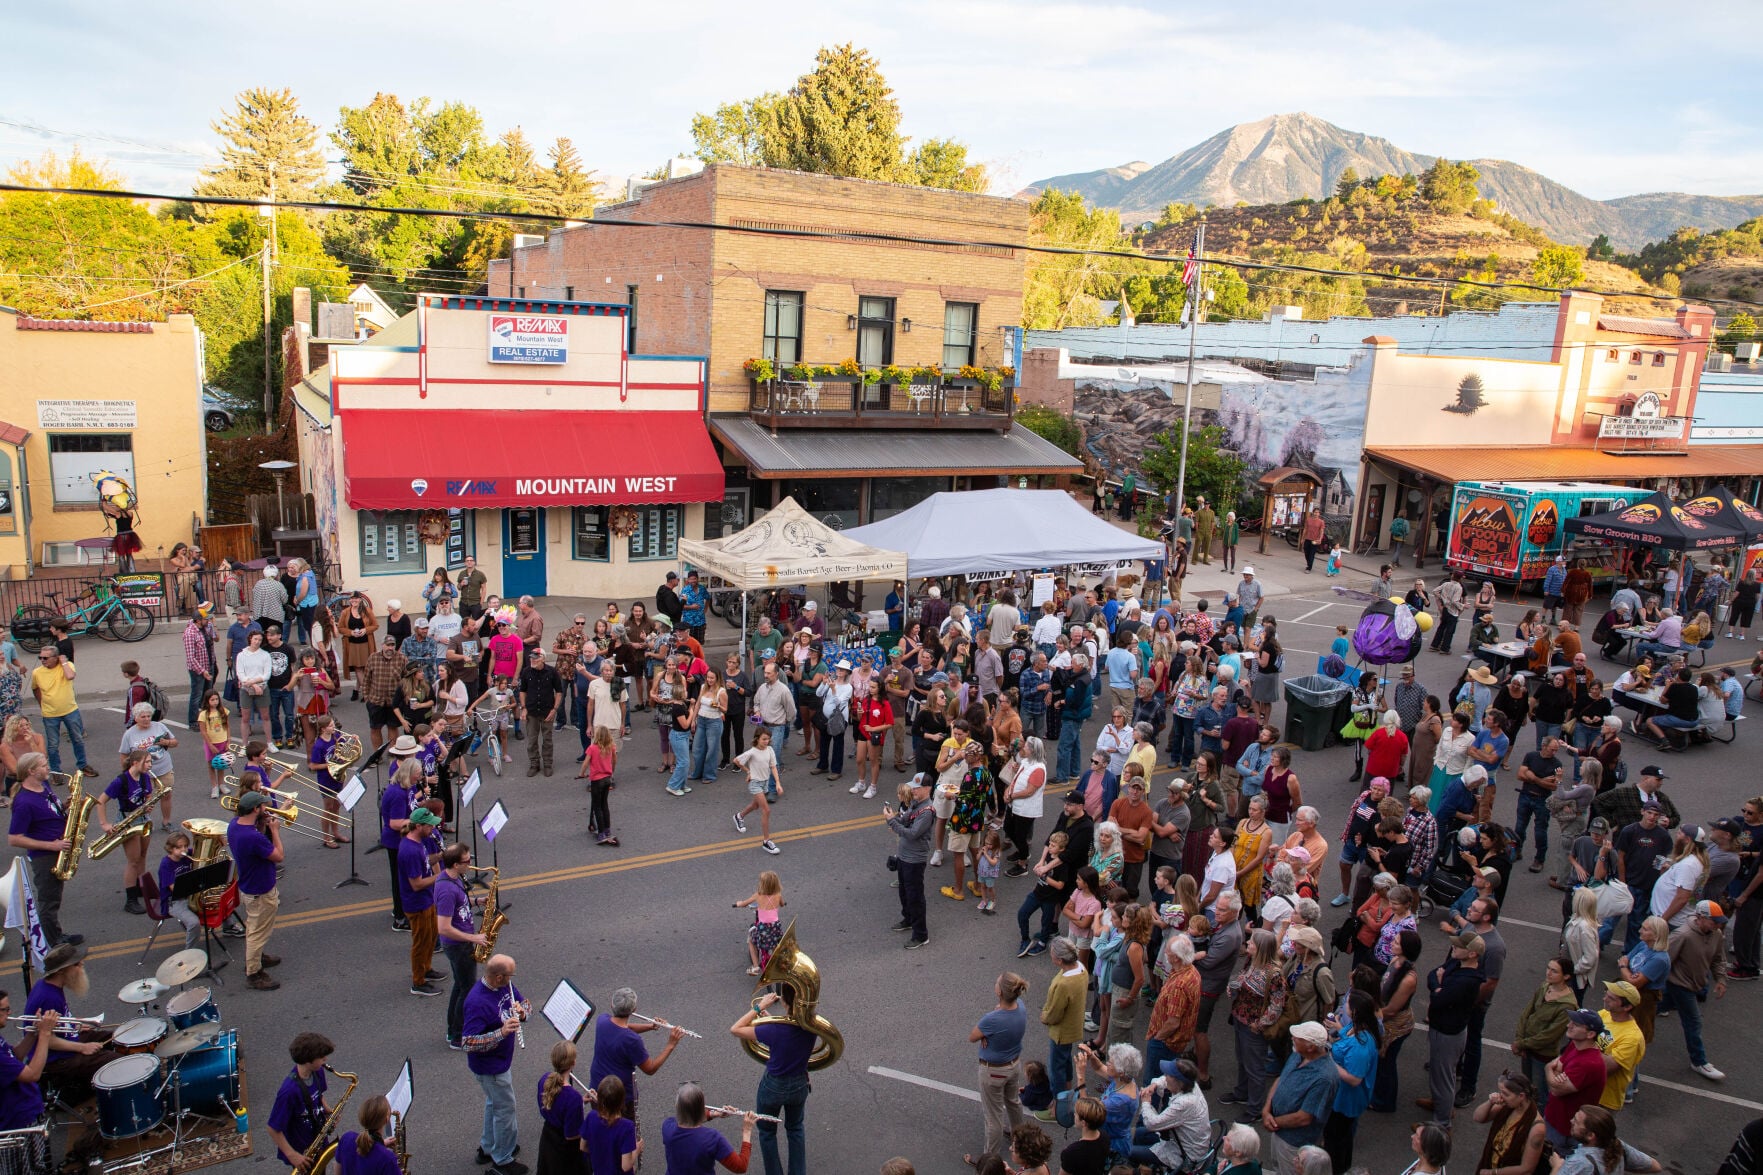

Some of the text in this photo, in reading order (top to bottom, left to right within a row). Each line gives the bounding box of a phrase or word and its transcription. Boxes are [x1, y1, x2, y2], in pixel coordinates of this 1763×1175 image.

[516, 318, 562, 333] RE/MAX
[500, 348, 559, 357] REAL ESTATE
[446, 477, 677, 496] RE/MAX MOUNTAIN WEST
[1469, 513, 1506, 530] slow
[1462, 526, 1511, 543] groovin
[1583, 525, 1662, 544] Slow Groovin BBQ
[1471, 537, 1498, 552] BBQ
[1696, 539, 1708, 547] Slow
[1708, 538, 1725, 546] Groovin
[835, 564, 850, 572] Beer
[1077, 562, 1108, 571] ICKETS
[968, 570, 1007, 580] DRINKS
